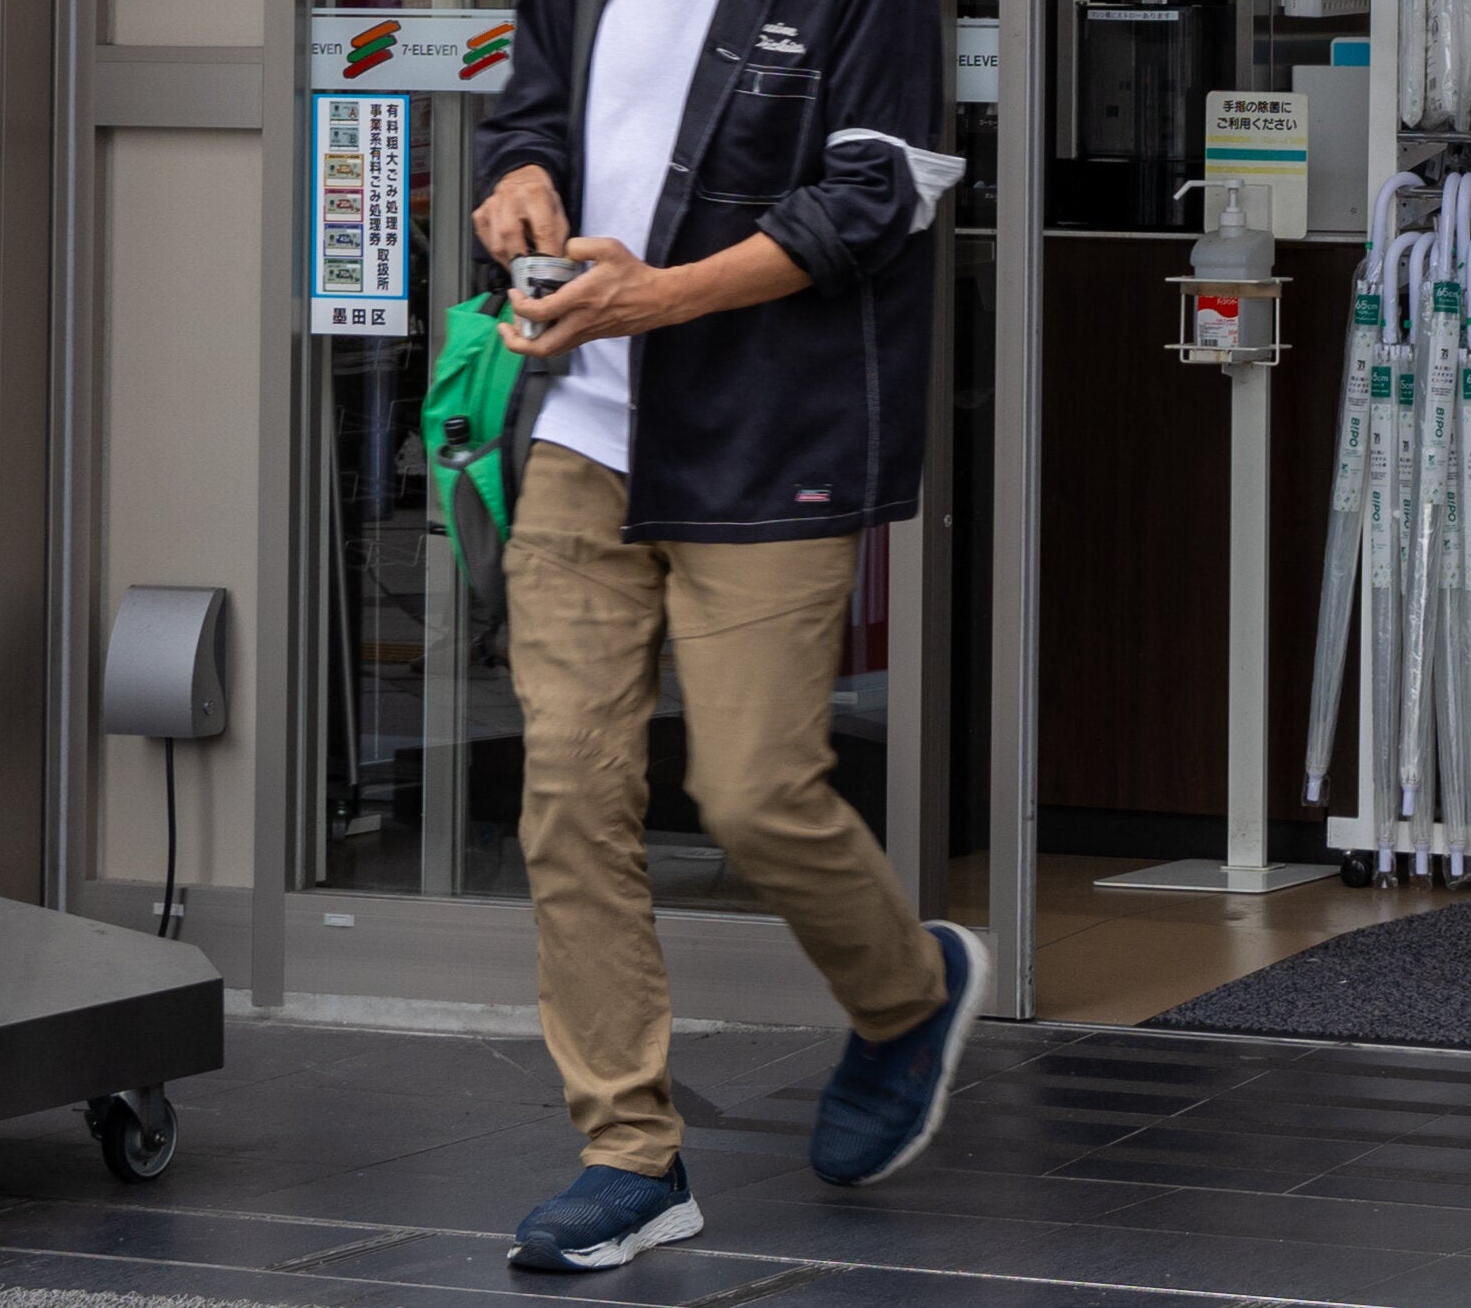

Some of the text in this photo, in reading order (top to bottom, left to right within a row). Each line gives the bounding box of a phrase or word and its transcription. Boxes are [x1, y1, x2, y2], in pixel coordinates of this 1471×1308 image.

[1223, 100, 1292, 114] 手指の除菌に
[1216, 117, 1297, 131] ご利用ください
[369, 103, 382, 247] 事業系有料ごみ処理券
[386, 103, 399, 247] 有料粗大ごみ処理券
[376, 248, 390, 292] 取扱所
[332, 307, 386, 326] 墨田区
